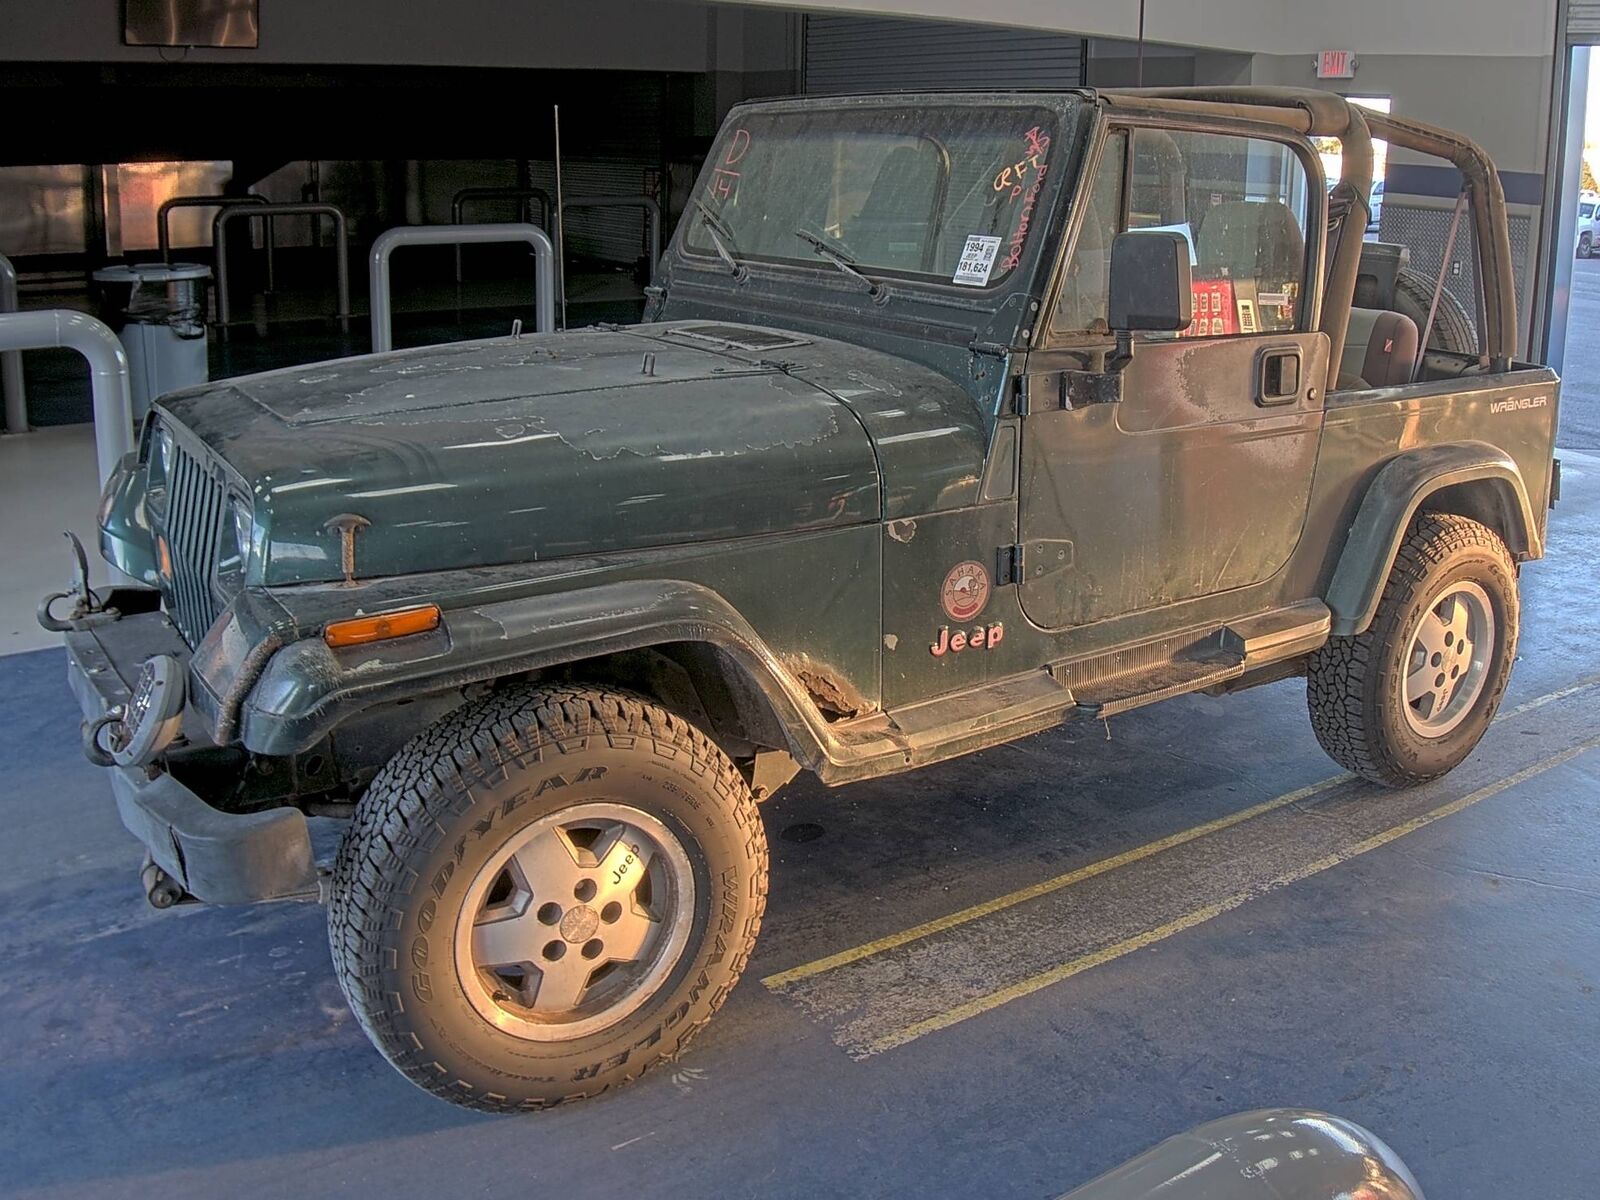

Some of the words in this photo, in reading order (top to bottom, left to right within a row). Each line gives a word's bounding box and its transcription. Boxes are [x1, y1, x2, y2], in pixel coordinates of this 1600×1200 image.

[1323, 51, 1348, 75] EXIT
[966, 242, 984, 252] 1994
[958, 261, 989, 273] 181,624
[1490, 396, 1547, 414] WRANGLER
[945, 565, 986, 596] SAHARA
[929, 622, 1003, 656] Jeep
[612, 844, 640, 885] Jeep
[411, 765, 609, 1004] GOODYEAR
[570, 866, 740, 1084] WRANGLER
